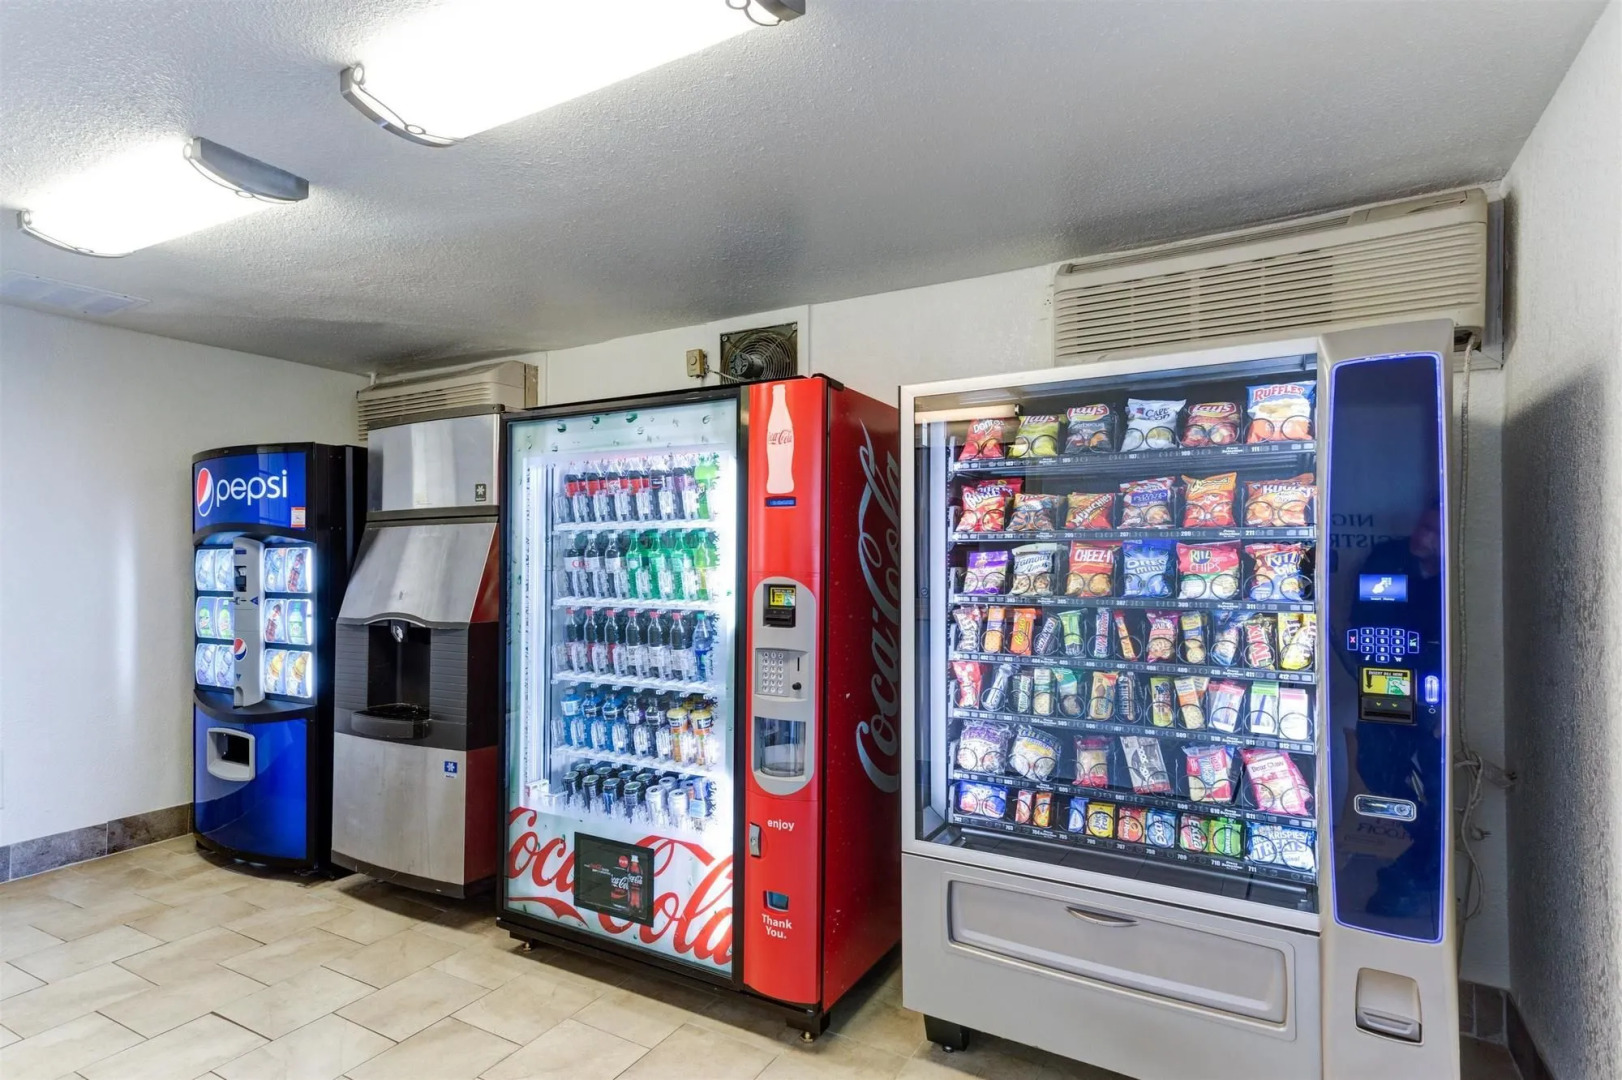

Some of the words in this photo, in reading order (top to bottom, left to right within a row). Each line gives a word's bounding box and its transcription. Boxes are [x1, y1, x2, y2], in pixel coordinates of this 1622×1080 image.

[1254, 385, 1304, 400] RUFFLES
[216, 469, 288, 507] pepsi
[767, 819, 795, 832] enjoy
[1255, 838, 1308, 860] TREATS
[508, 806, 732, 965] ocaCola
[761, 913, 793, 930] Thank
[765, 925, 788, 940] You.
